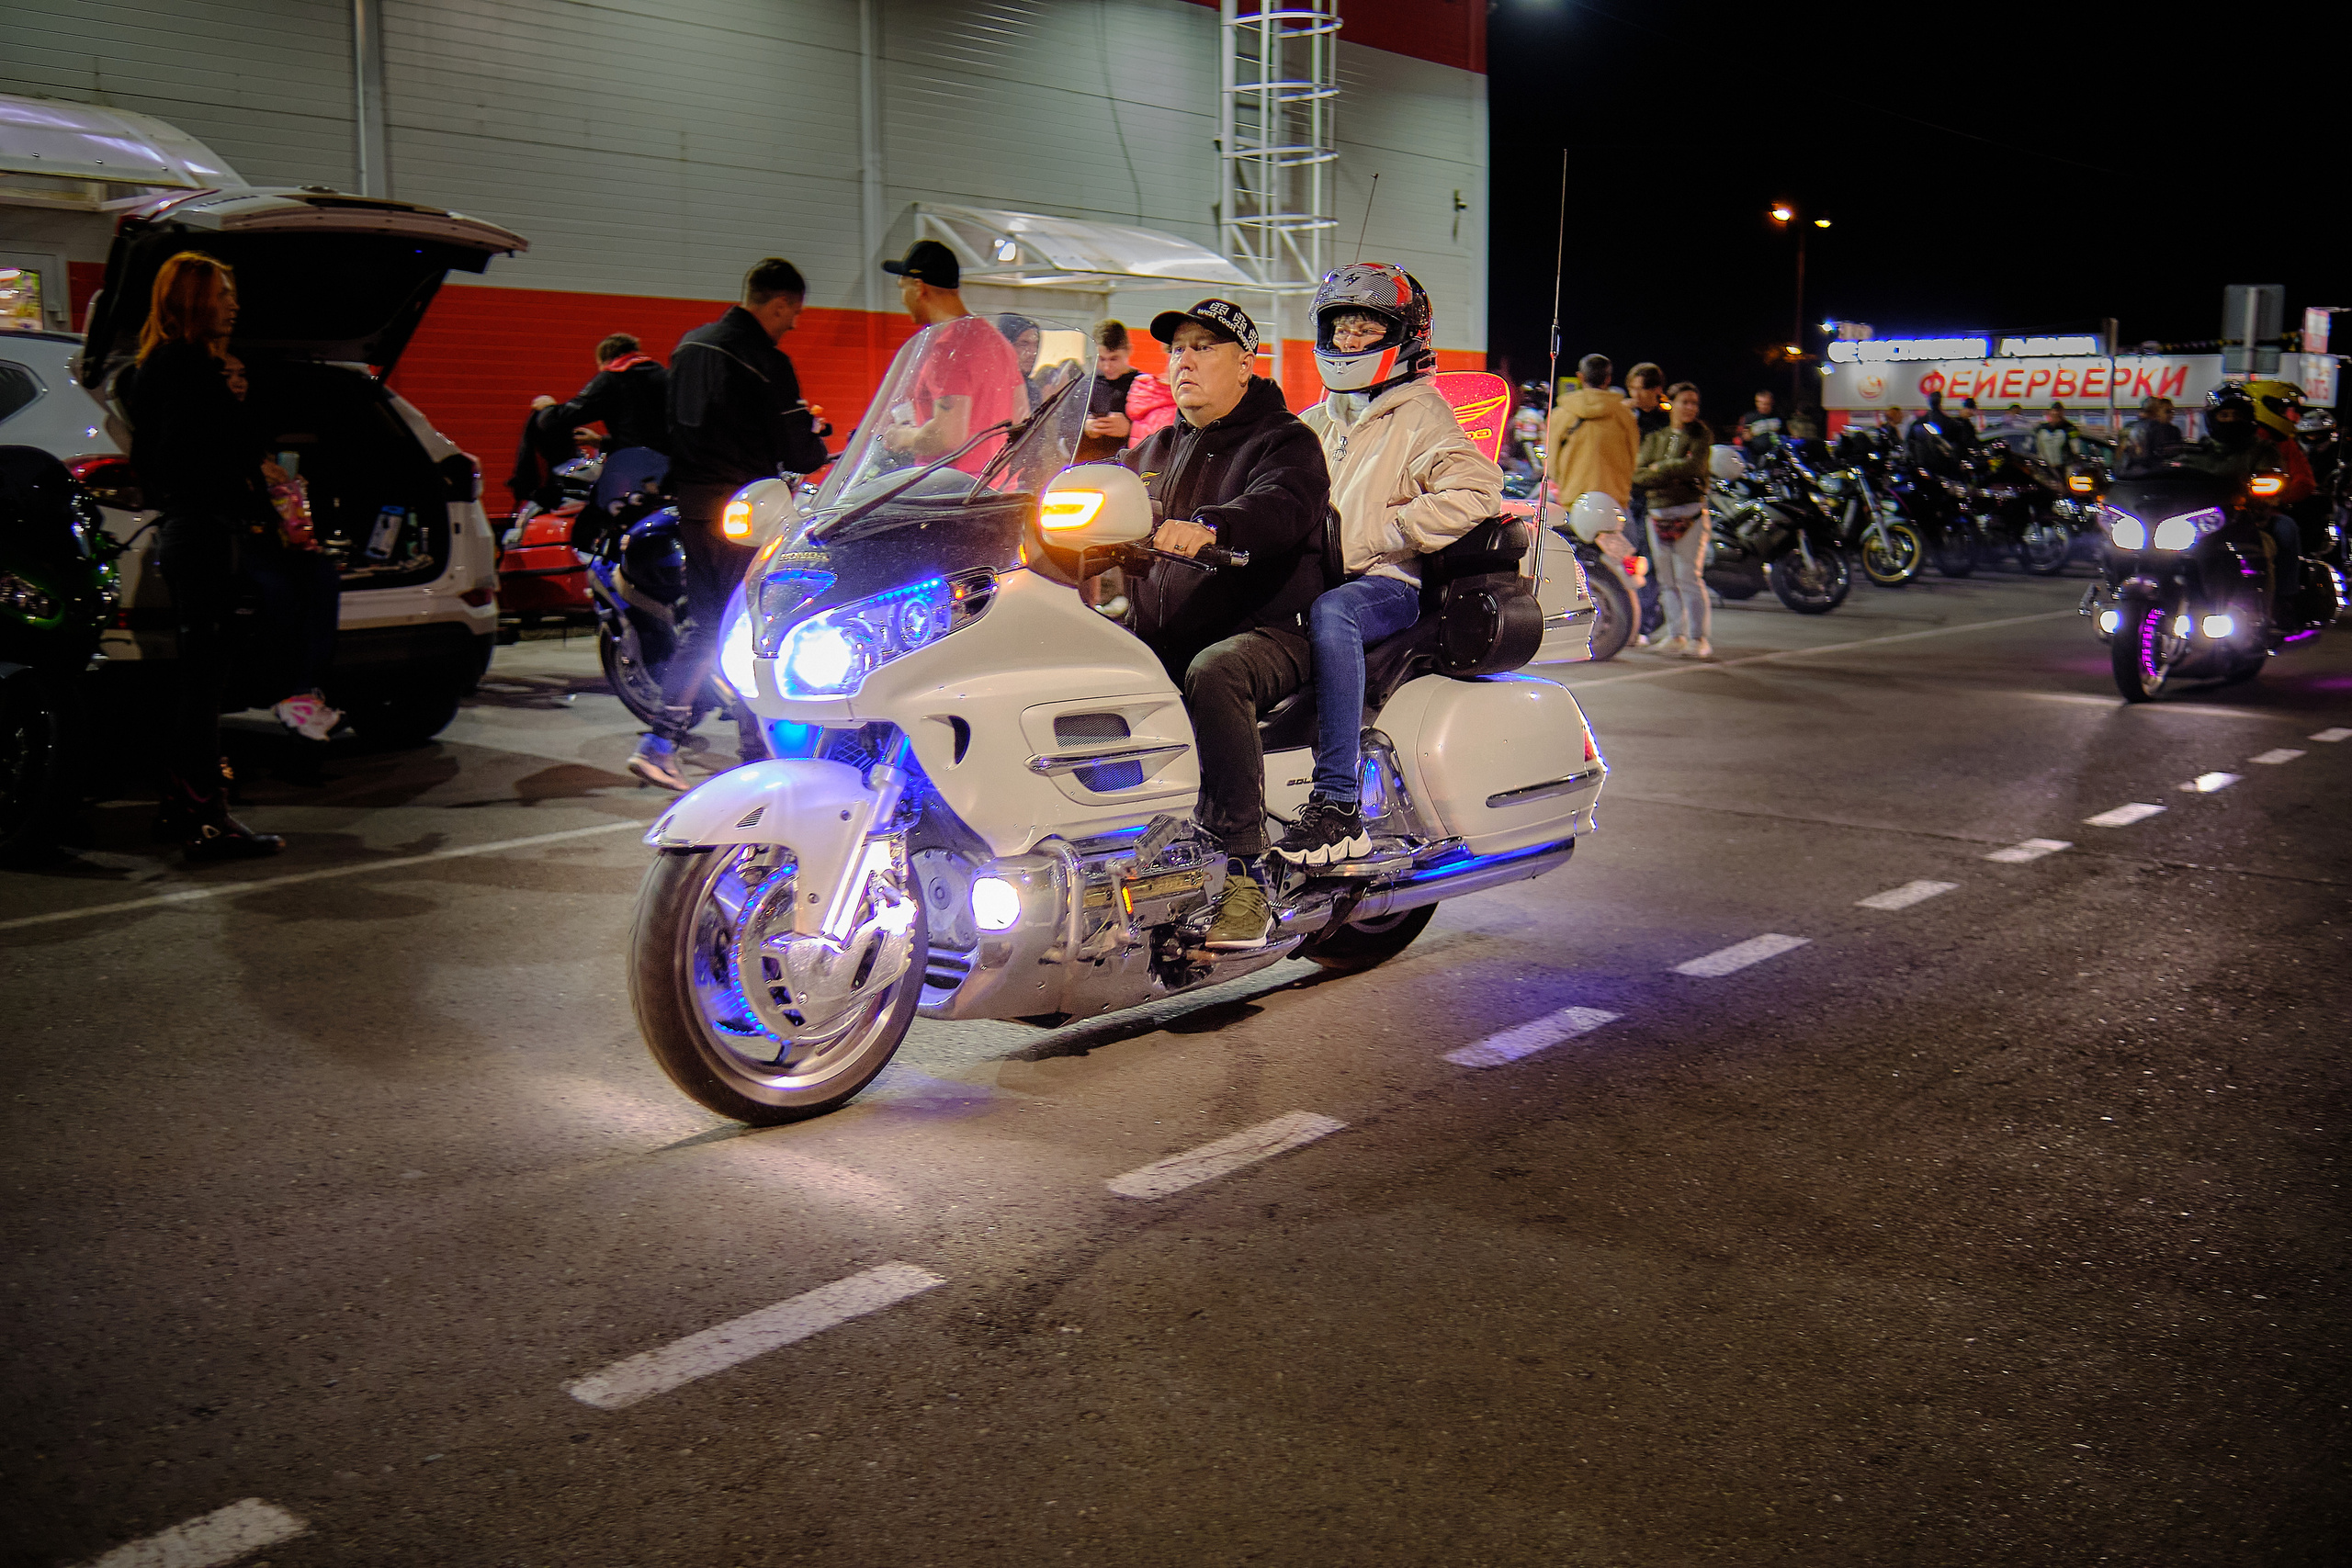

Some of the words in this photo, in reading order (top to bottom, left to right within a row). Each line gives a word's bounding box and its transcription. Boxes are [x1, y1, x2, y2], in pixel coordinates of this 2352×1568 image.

[1197, 308, 1217, 319] west
[1217, 315, 1238, 333] coast
[1286, 777, 1313, 786] GOL
